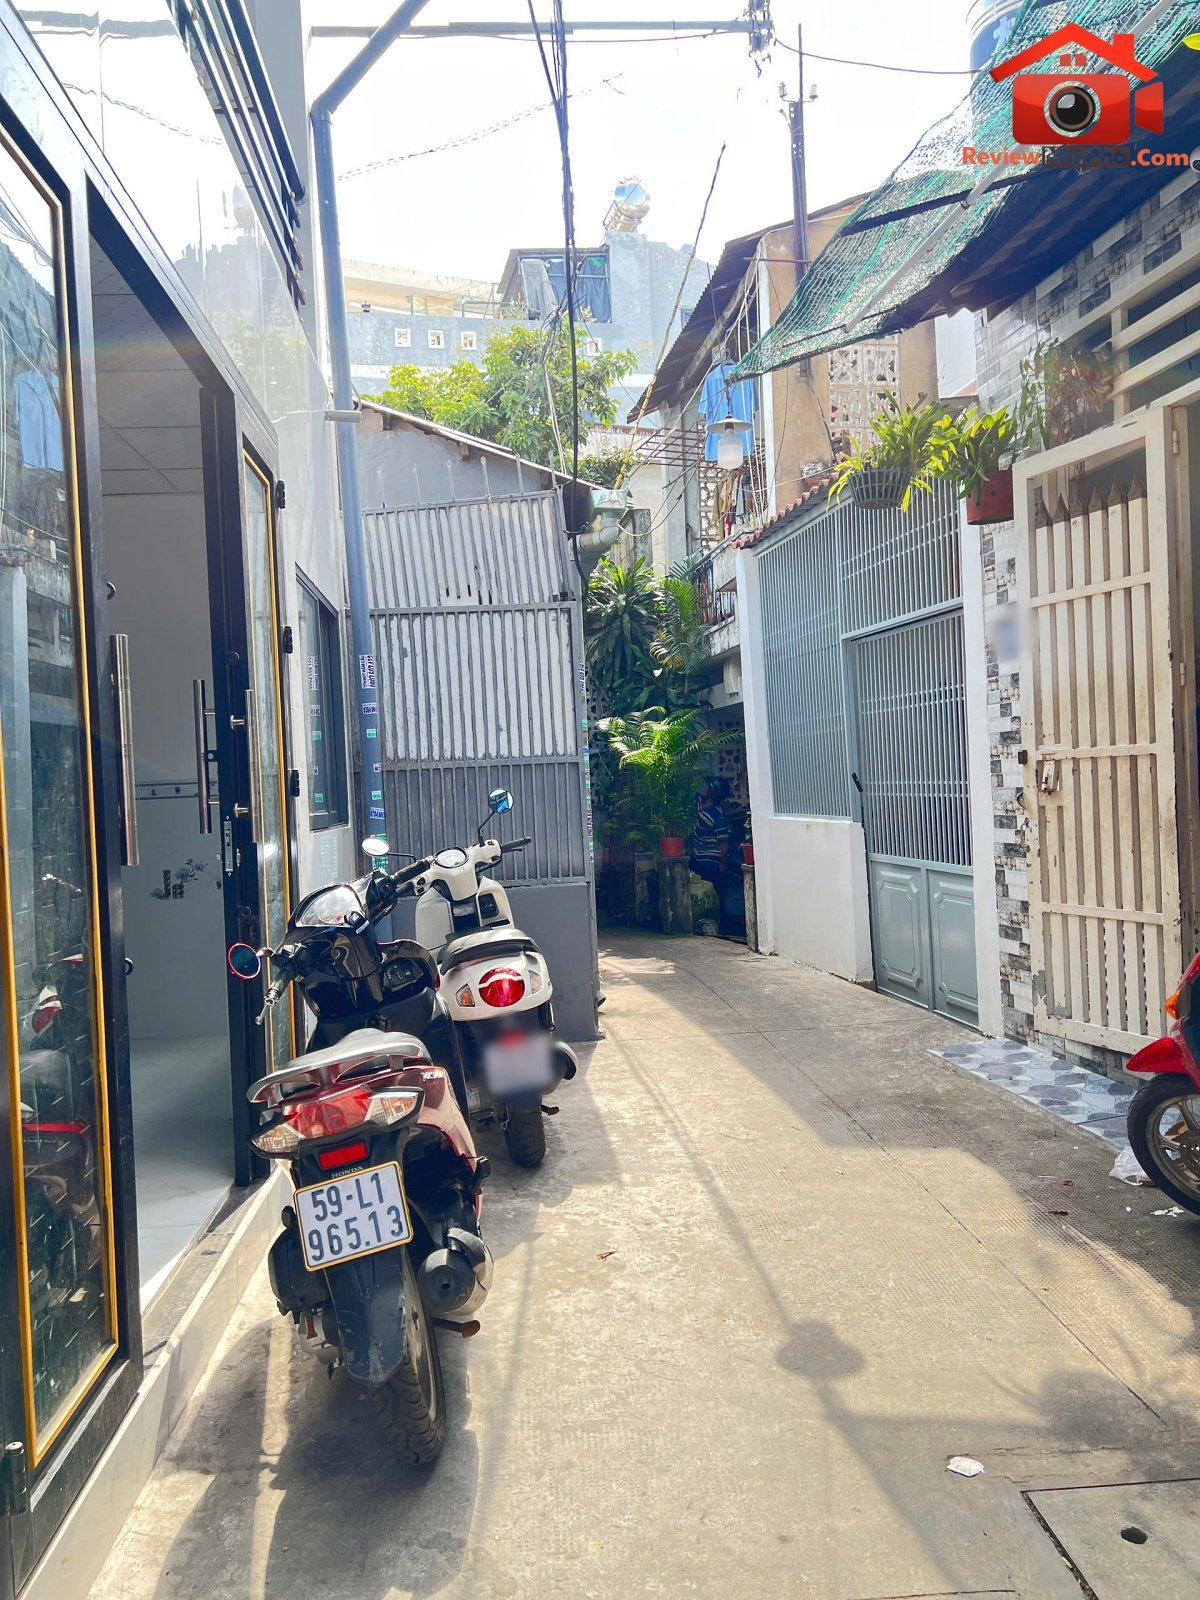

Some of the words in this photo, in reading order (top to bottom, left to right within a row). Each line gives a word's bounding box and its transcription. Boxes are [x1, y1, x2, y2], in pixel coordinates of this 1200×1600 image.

[331, 1166, 363, 1178] HONDA
[311, 1173, 383, 1221] 59-L1
[308, 1205, 403, 1261] 965.13
